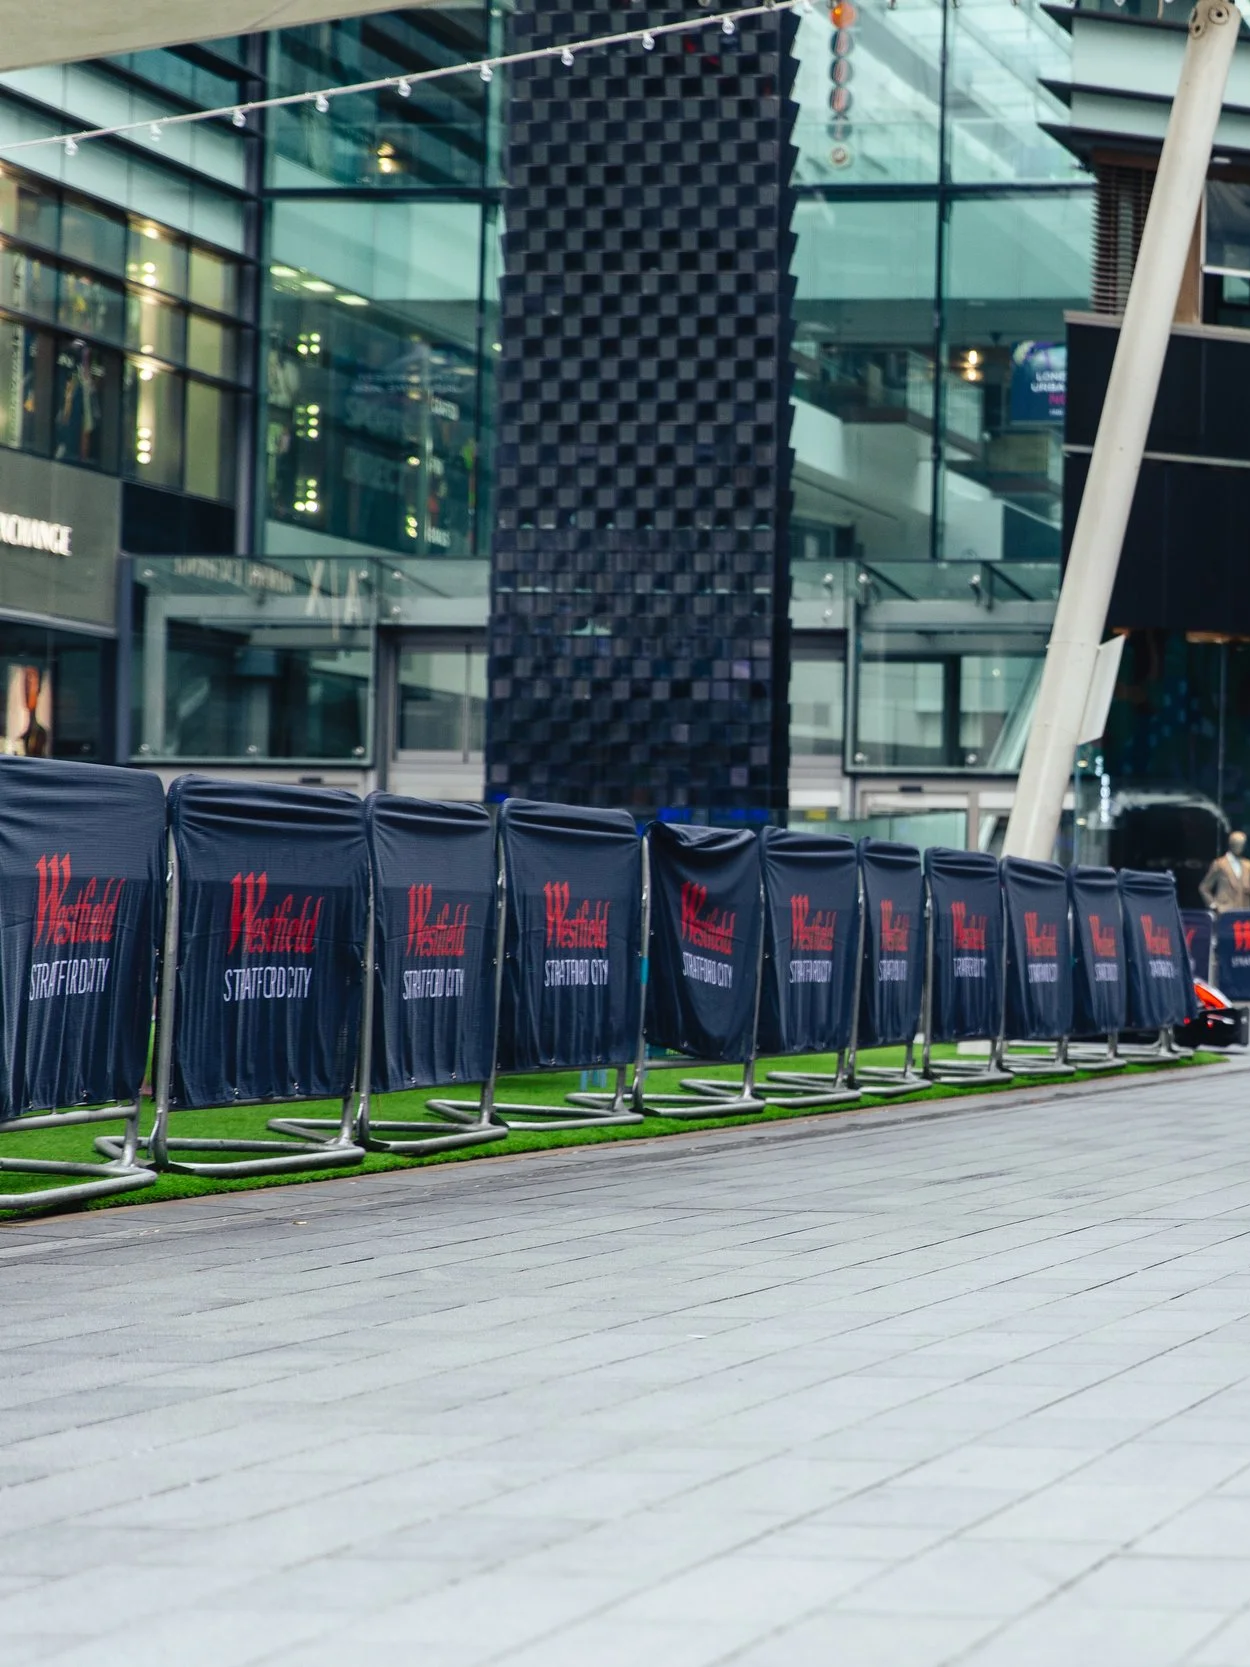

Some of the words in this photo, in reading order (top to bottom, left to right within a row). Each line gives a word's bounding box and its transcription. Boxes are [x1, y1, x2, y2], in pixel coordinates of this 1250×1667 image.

[34, 853, 126, 948] Westfield
[227, 871, 325, 956] Westfield
[405, 883, 471, 957] Westfield
[543, 881, 611, 949] Westfield
[681, 881, 737, 956] Westfield
[590, 959, 609, 986] CITY
